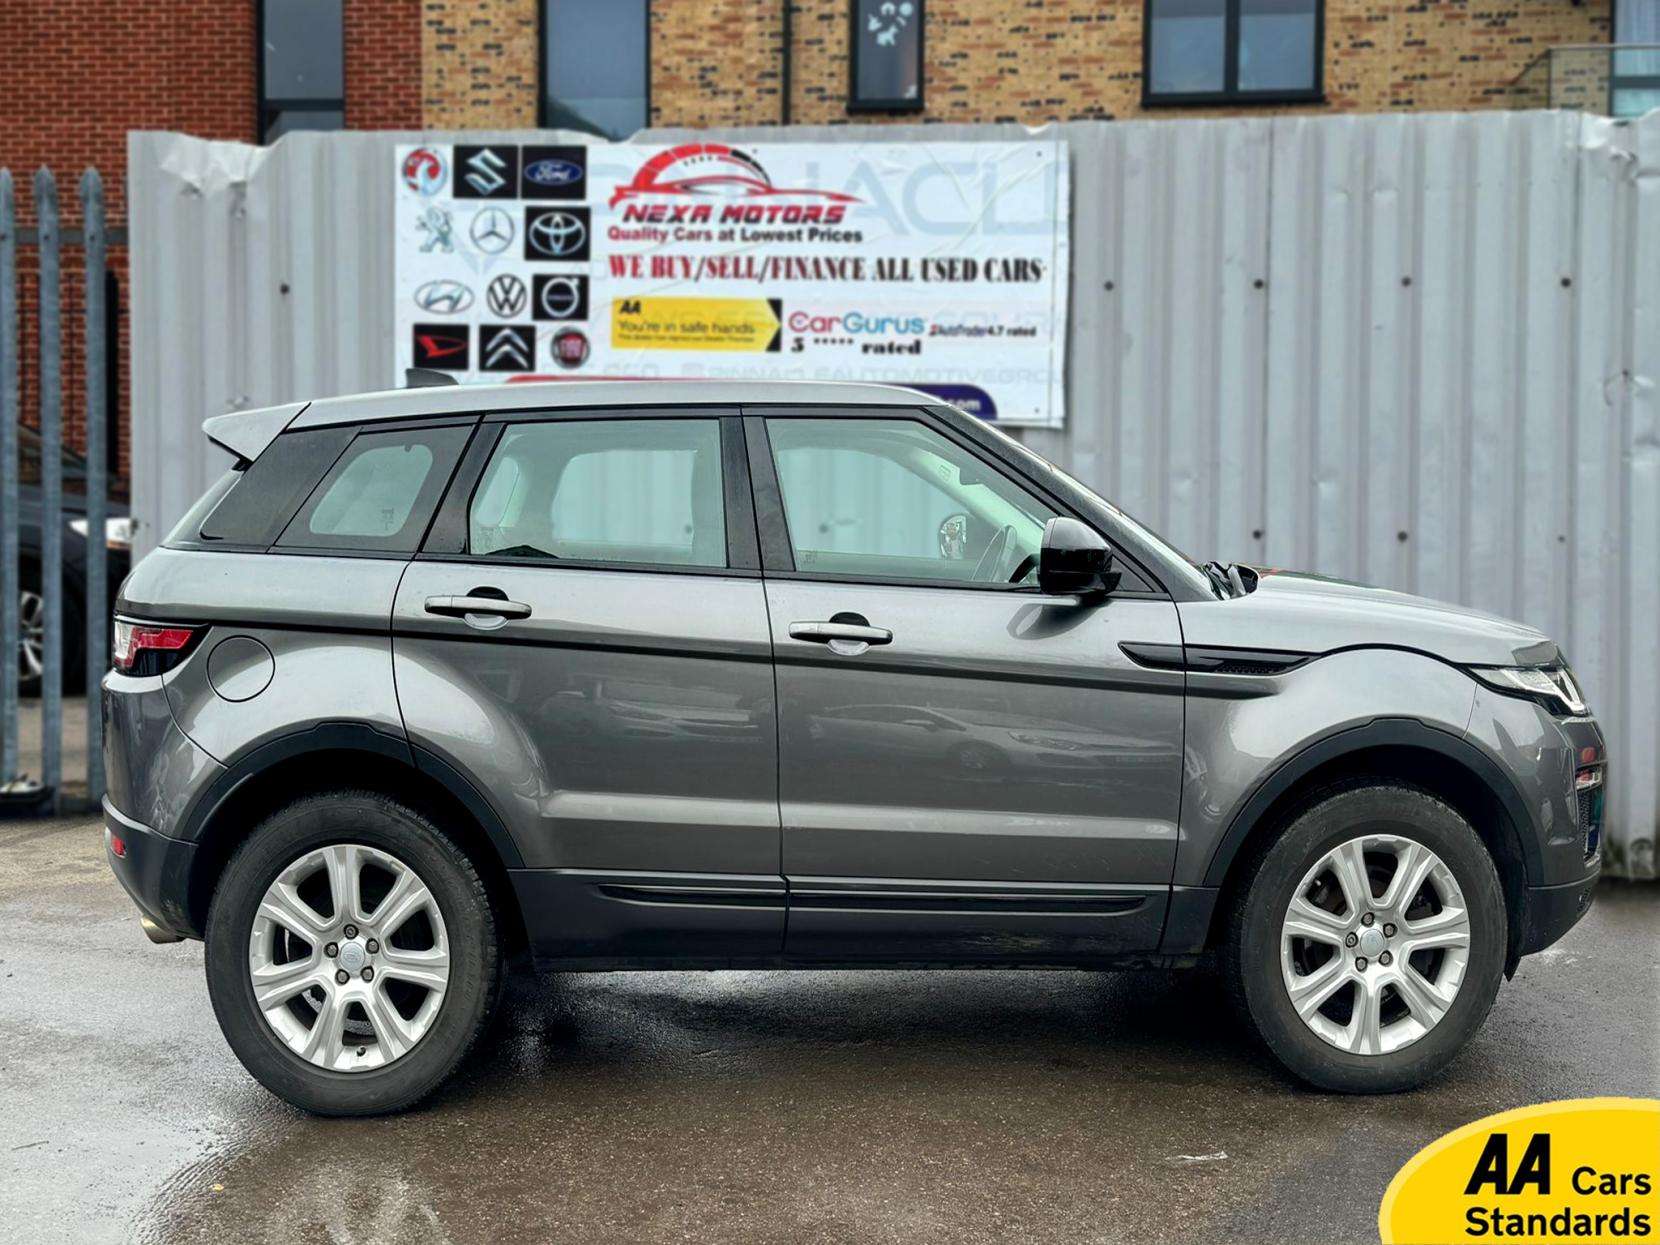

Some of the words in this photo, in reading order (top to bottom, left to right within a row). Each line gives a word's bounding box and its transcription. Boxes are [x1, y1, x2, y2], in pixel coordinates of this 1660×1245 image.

[622, 204, 712, 224] NEXA
[719, 205, 846, 225] MOTORS
[608, 226, 669, 243] Quality
[674, 227, 712, 242] Cars
[718, 229, 735, 242] at
[741, 228, 802, 243] Lowest
[808, 228, 863, 243] Prices
[608, 254, 644, 279] WE
[872, 257, 914, 282] ALL
[921, 257, 978, 283] USED
[984, 257, 1043, 283] CARS
[619, 300, 641, 314] AA
[665, 321, 677, 332] in
[680, 321, 708, 333] safe
[711, 322, 755, 334] hands
[788, 311, 925, 335] CarGurus
[862, 340, 921, 354] rated
